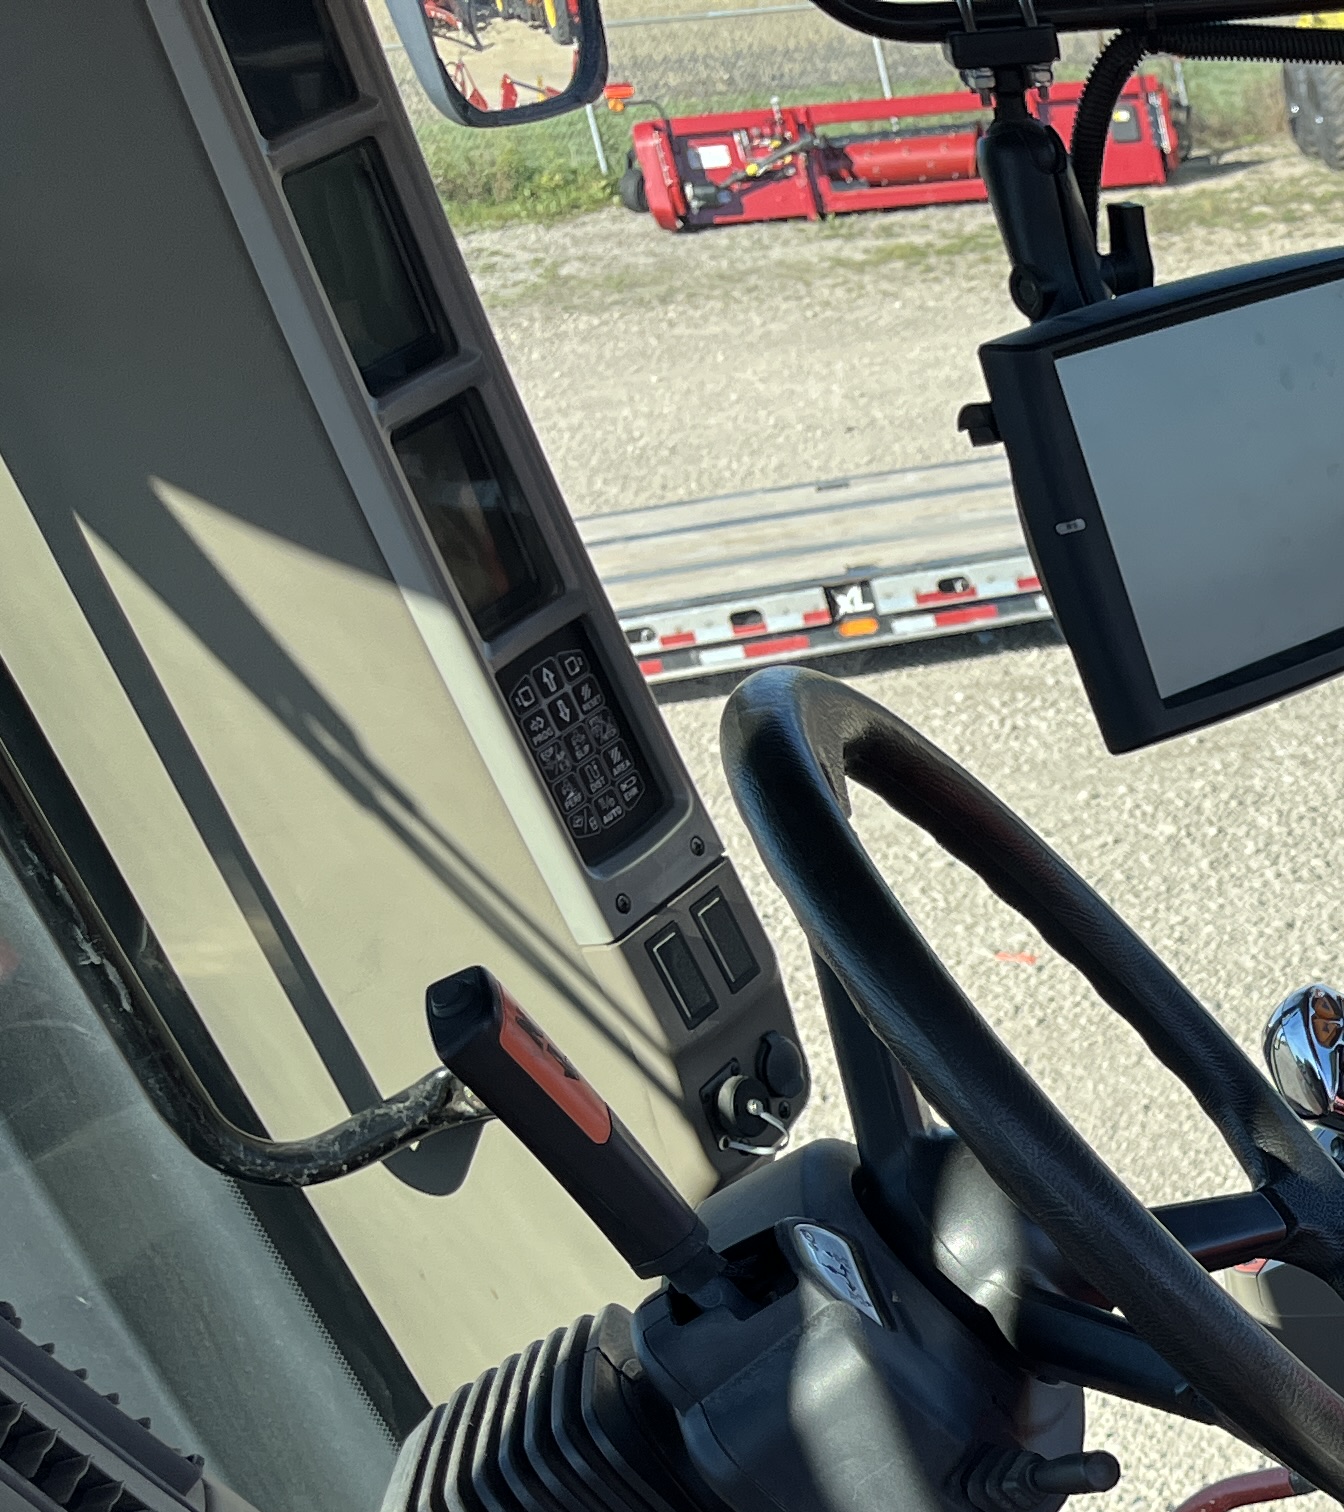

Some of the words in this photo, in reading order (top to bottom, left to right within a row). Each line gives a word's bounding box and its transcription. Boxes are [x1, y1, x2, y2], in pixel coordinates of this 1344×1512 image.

[830, 585, 875, 621] XL
[532, 726, 554, 746] PROG
[612, 759, 632, 777] AREA
[603, 805, 622, 824] AUTO
